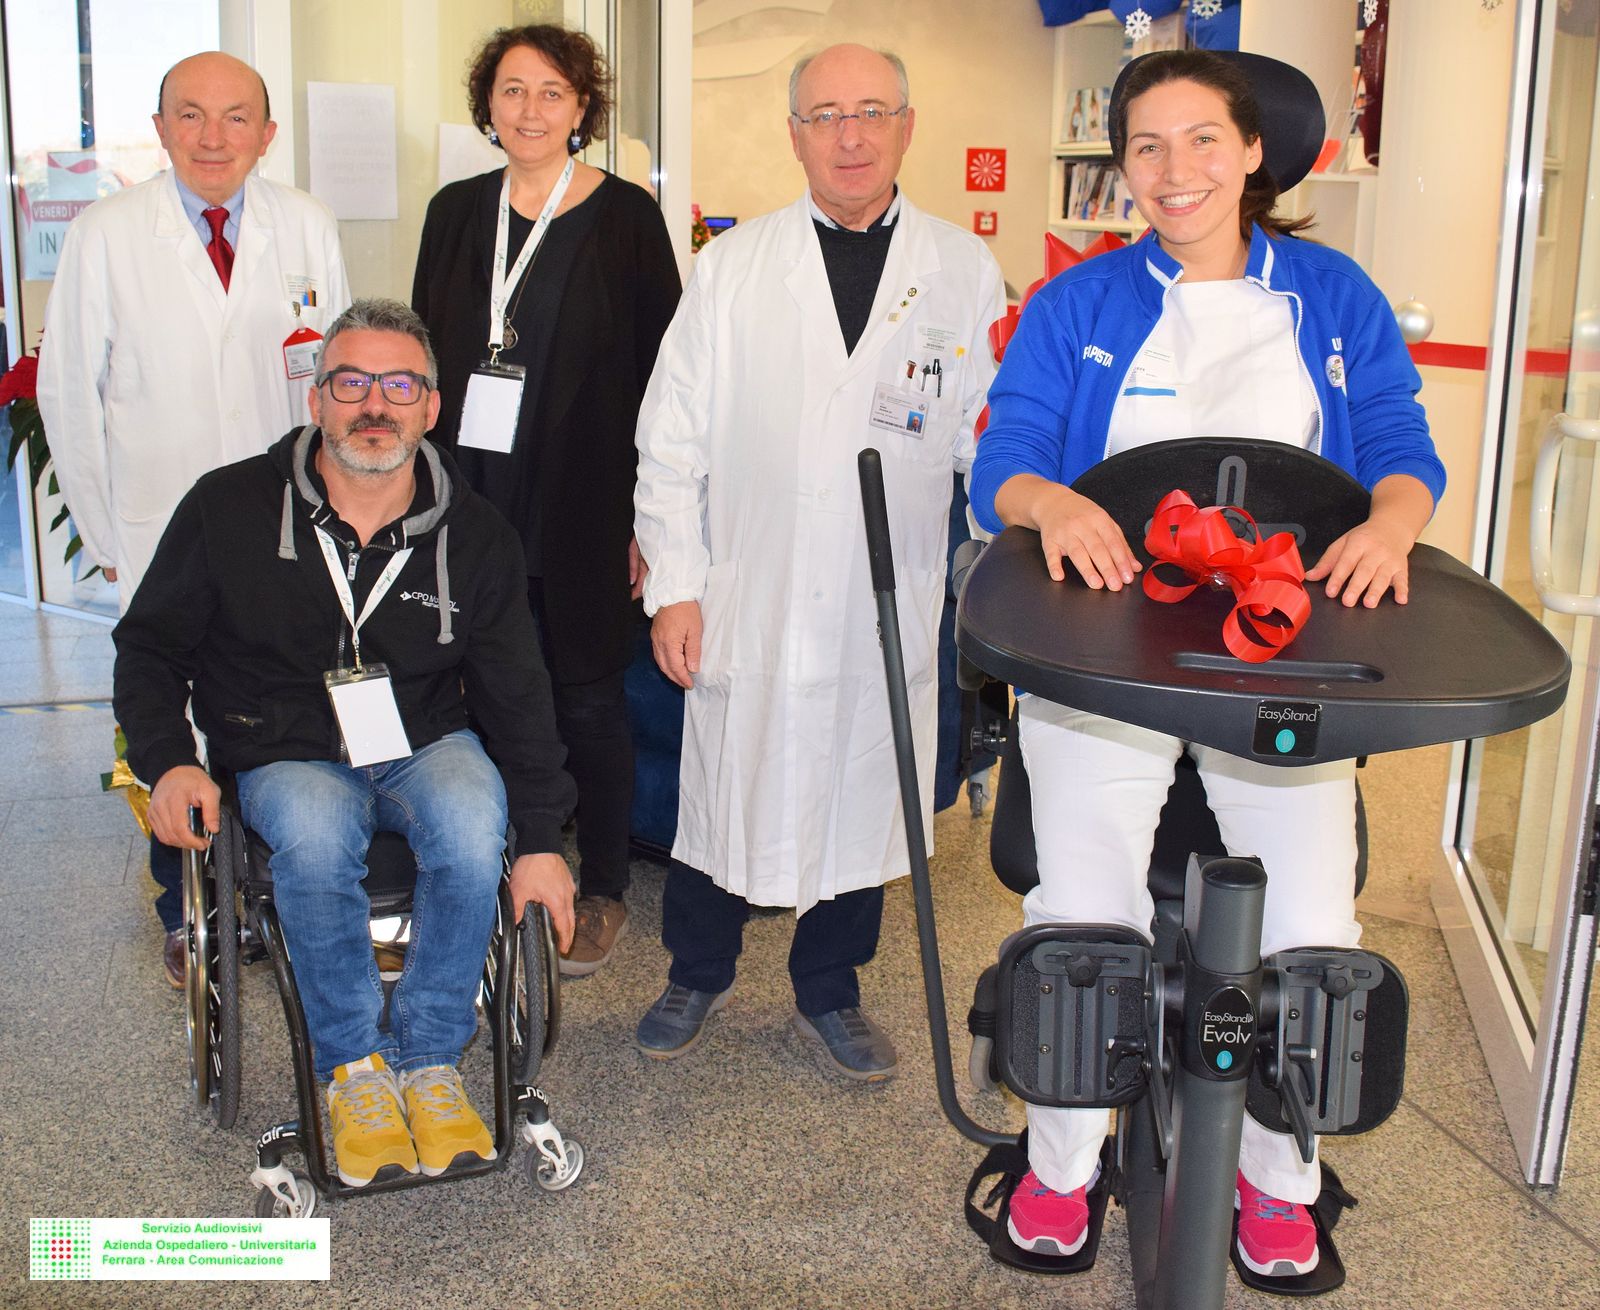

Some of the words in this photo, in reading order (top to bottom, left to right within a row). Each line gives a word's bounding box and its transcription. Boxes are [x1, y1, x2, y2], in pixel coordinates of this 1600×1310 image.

[39, 231, 57, 254] IN
[411, 591, 430, 602] CPO
[1258, 706, 1318, 723] EasyStand
[1203, 1024, 1252, 1045] Evolv
